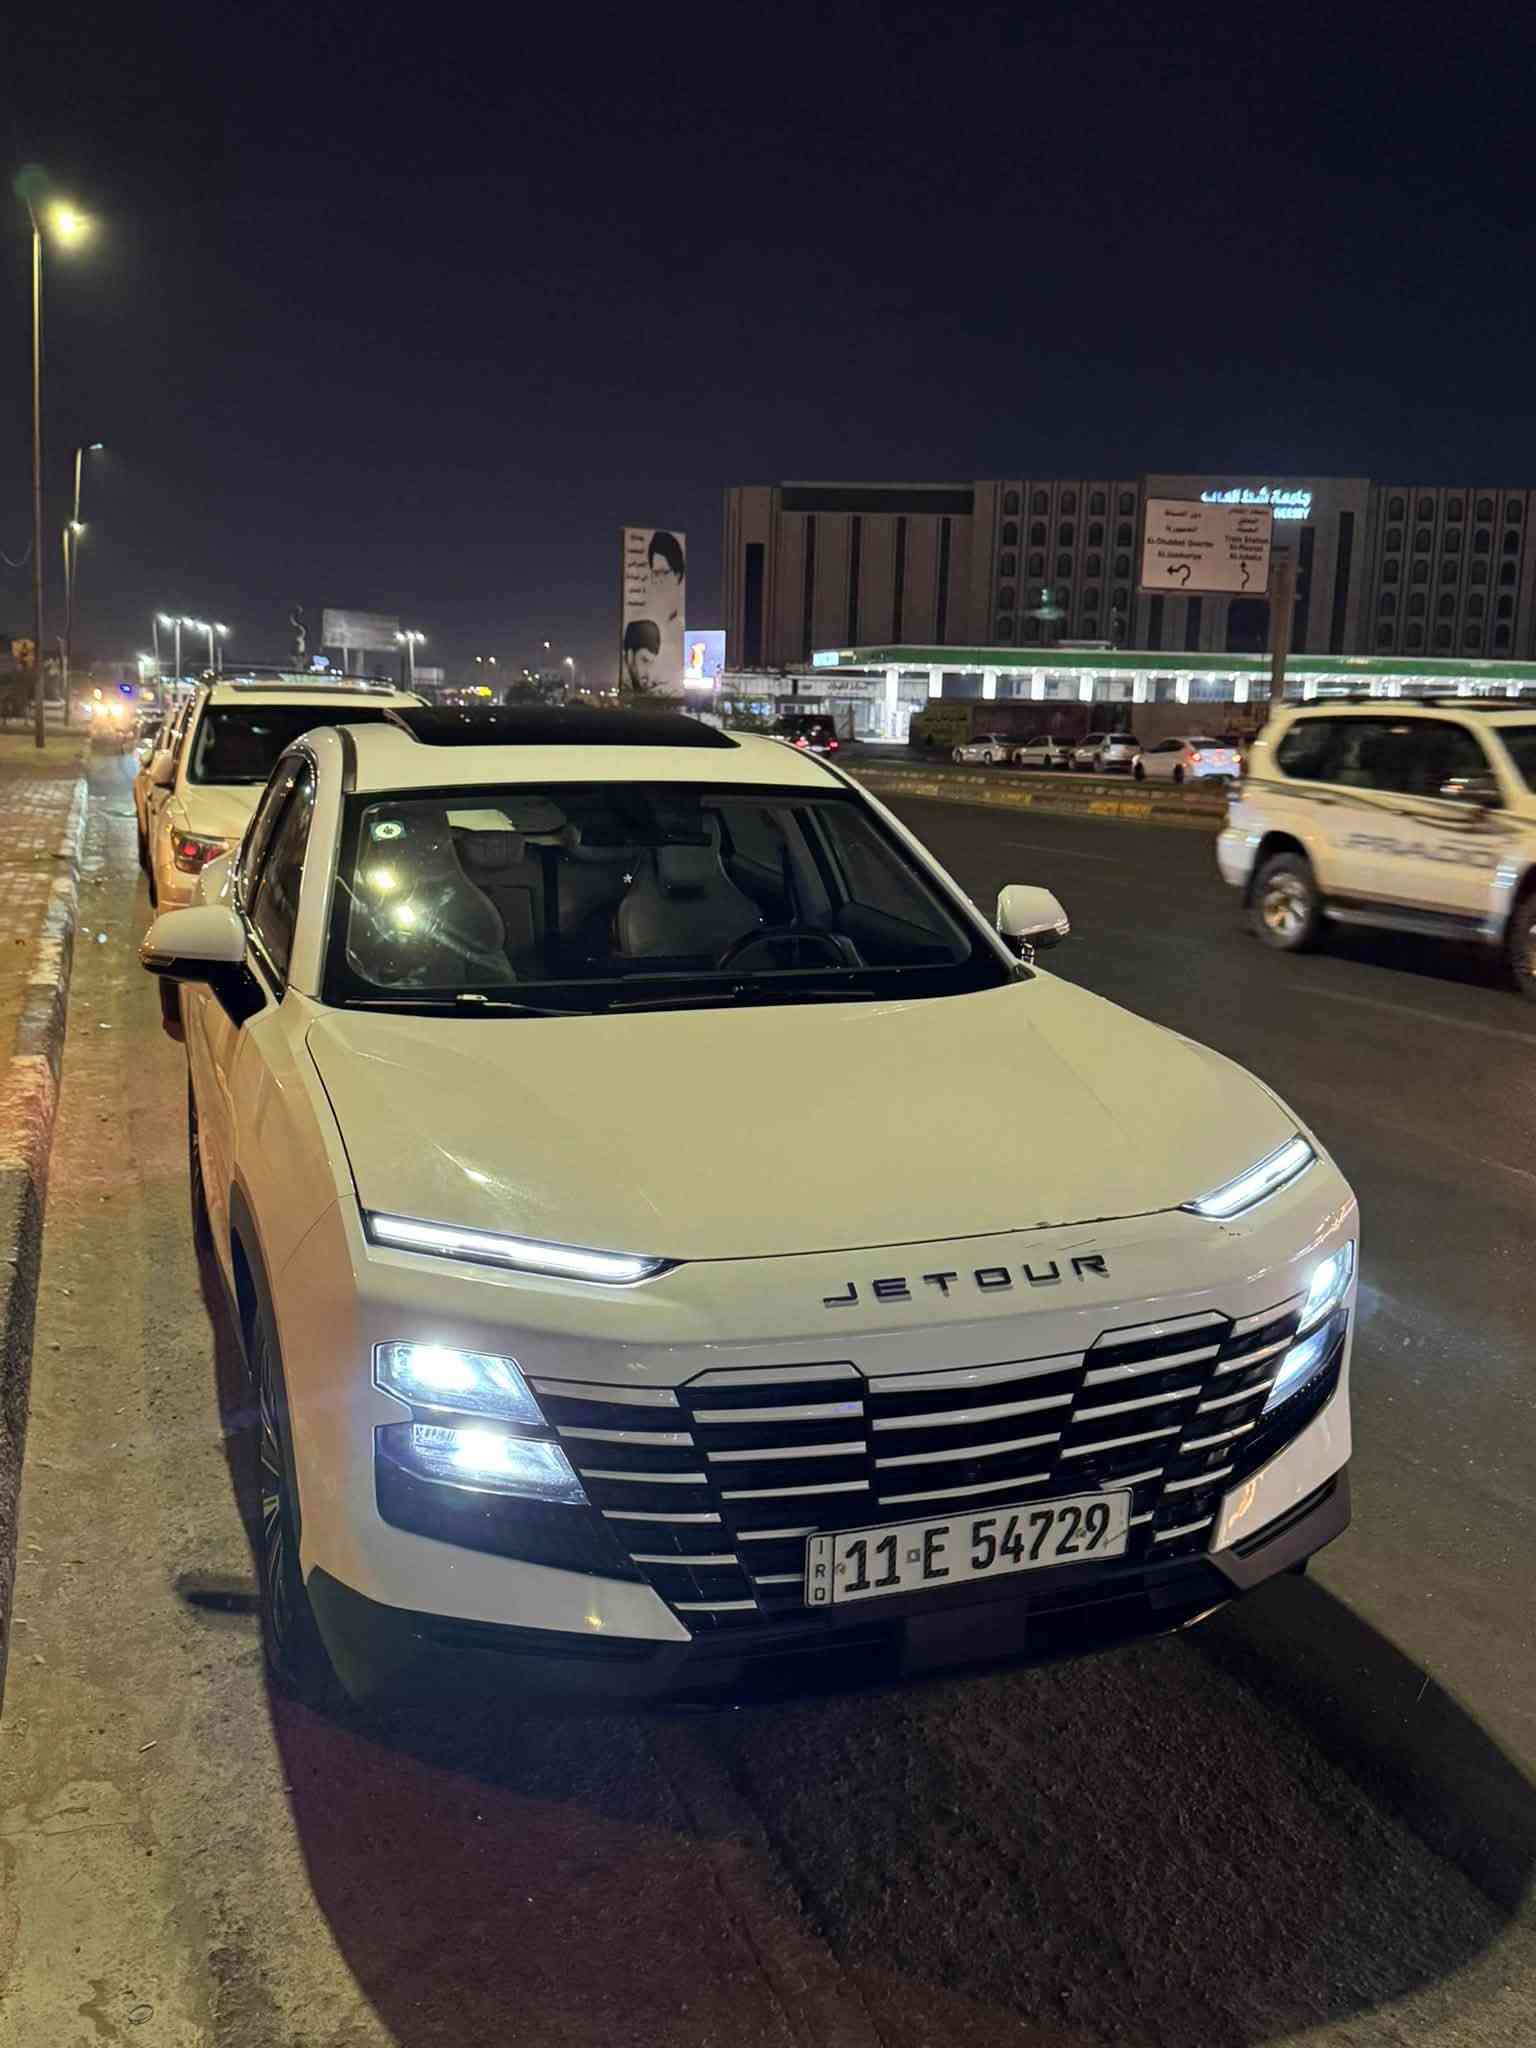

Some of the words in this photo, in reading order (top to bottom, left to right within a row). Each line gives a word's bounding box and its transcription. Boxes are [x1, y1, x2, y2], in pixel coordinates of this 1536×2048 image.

[822, 1255, 1109, 1306] JETOUR
[844, 1534, 901, 1593] 11
[923, 1526, 950, 1580] E
[971, 1502, 1111, 1571] 54729
